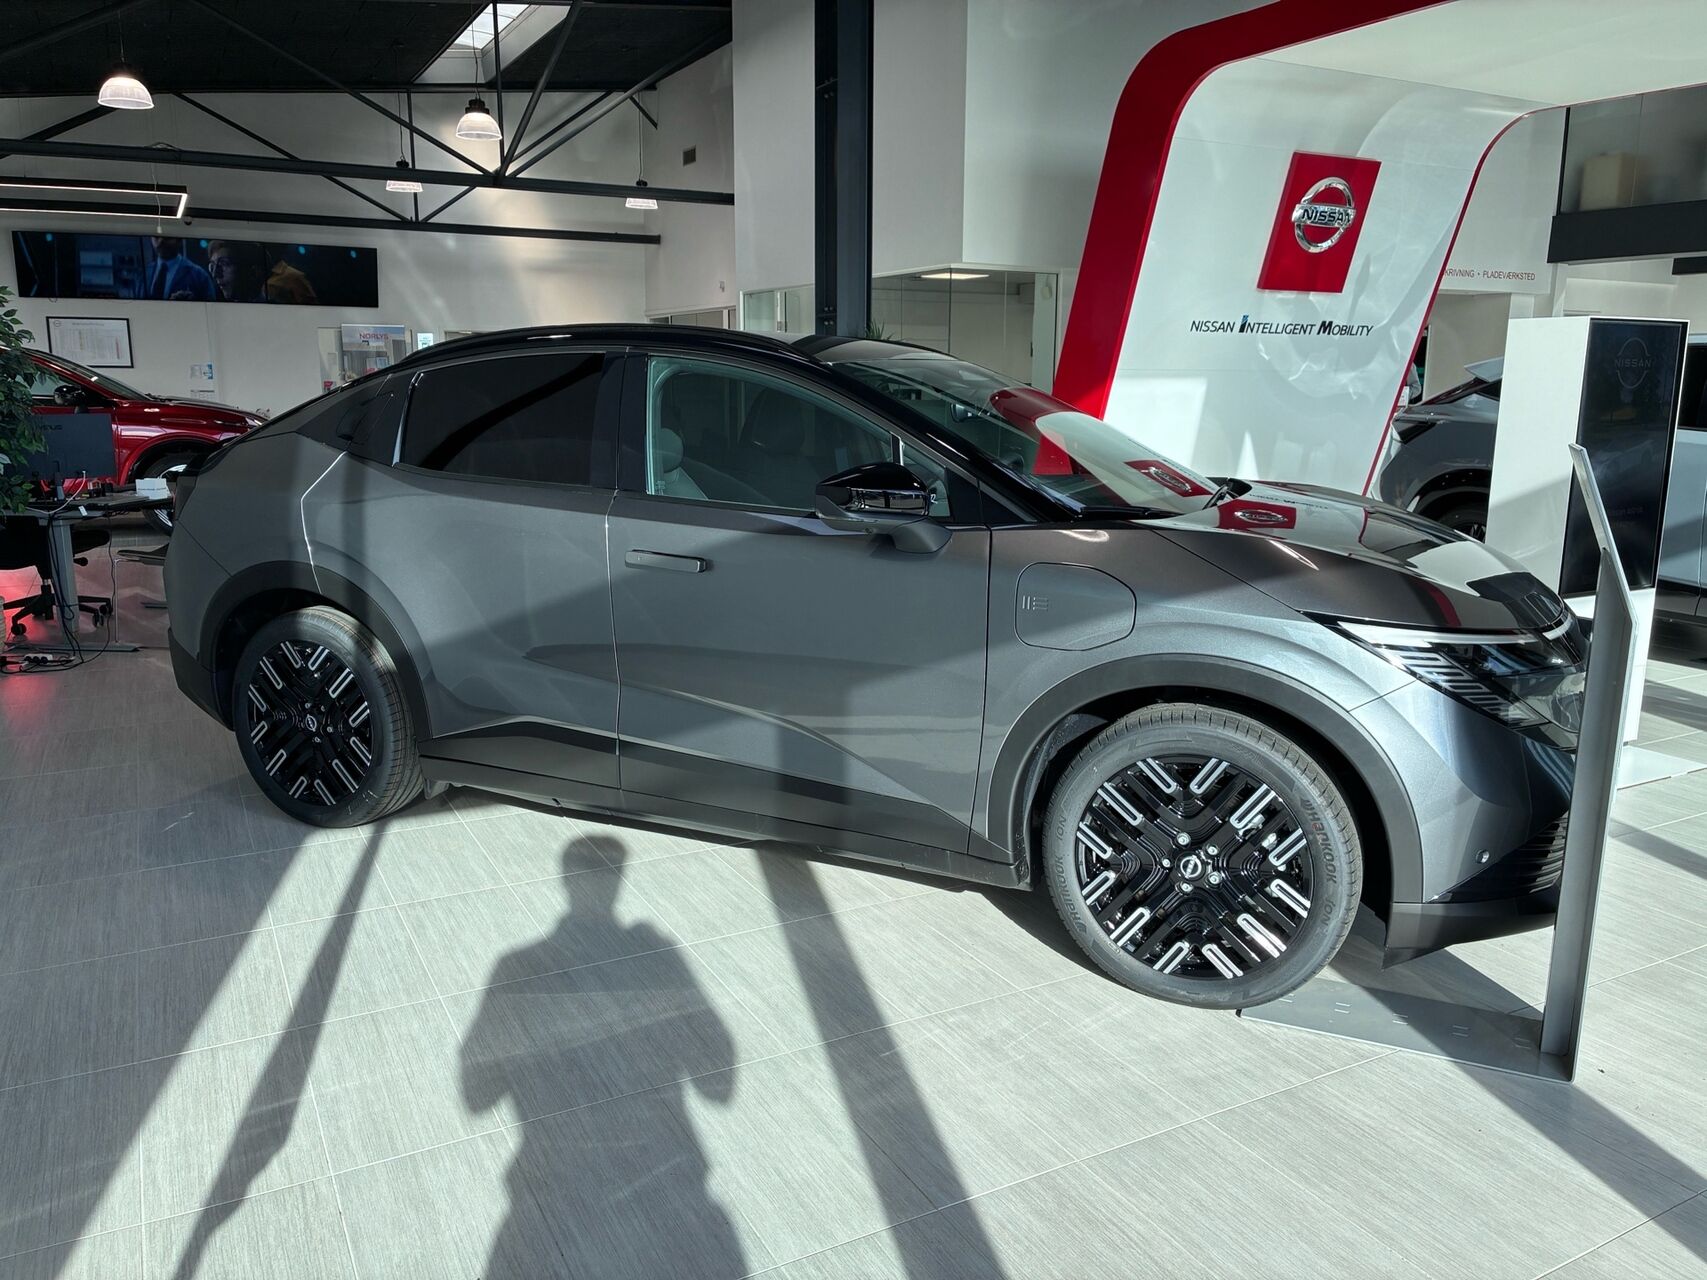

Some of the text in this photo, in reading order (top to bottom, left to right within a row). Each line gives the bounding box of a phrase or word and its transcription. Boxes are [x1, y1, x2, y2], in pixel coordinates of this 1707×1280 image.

[1482, 270, 1536, 281] PLADEVÆRKSTED
[1190, 314, 1374, 337] NISSAN INTELLIGENT MOBILITY
[1615, 358, 1652, 368] NISSAN
